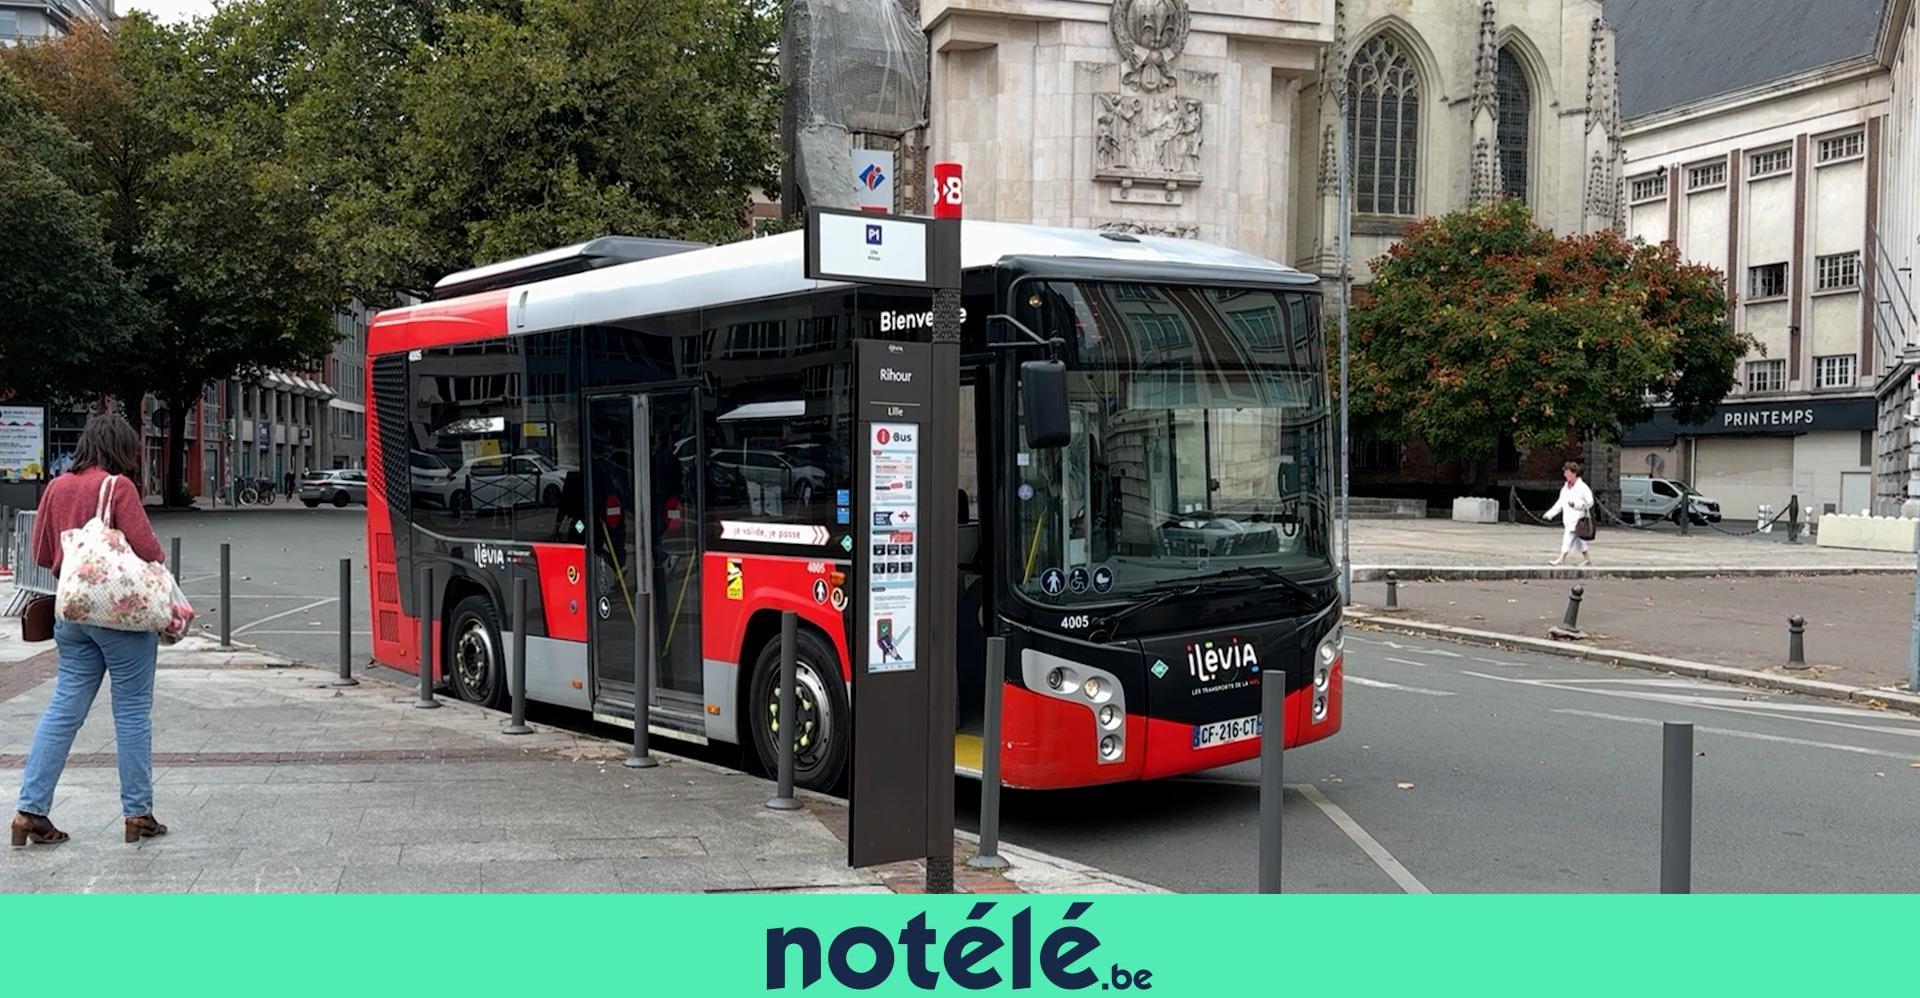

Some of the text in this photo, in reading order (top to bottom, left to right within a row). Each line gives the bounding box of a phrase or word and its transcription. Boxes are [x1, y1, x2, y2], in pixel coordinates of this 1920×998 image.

[868, 228, 880, 241] P1
[880, 305, 967, 332] Bienvee
[880, 368, 912, 383] Rihour
[888, 407, 904, 417] Lille
[1724, 409, 1814, 427] PRINTEMPS
[892, 432, 912, 442] Bus
[1060, 615, 1089, 629] 4005
[1191, 688, 1202, 696] LES
[1202, 682, 1235, 694] TRANSPORTS
[1234, 681, 1242, 689] DE
[1201, 718, 1257, 744] CF-216-CT
